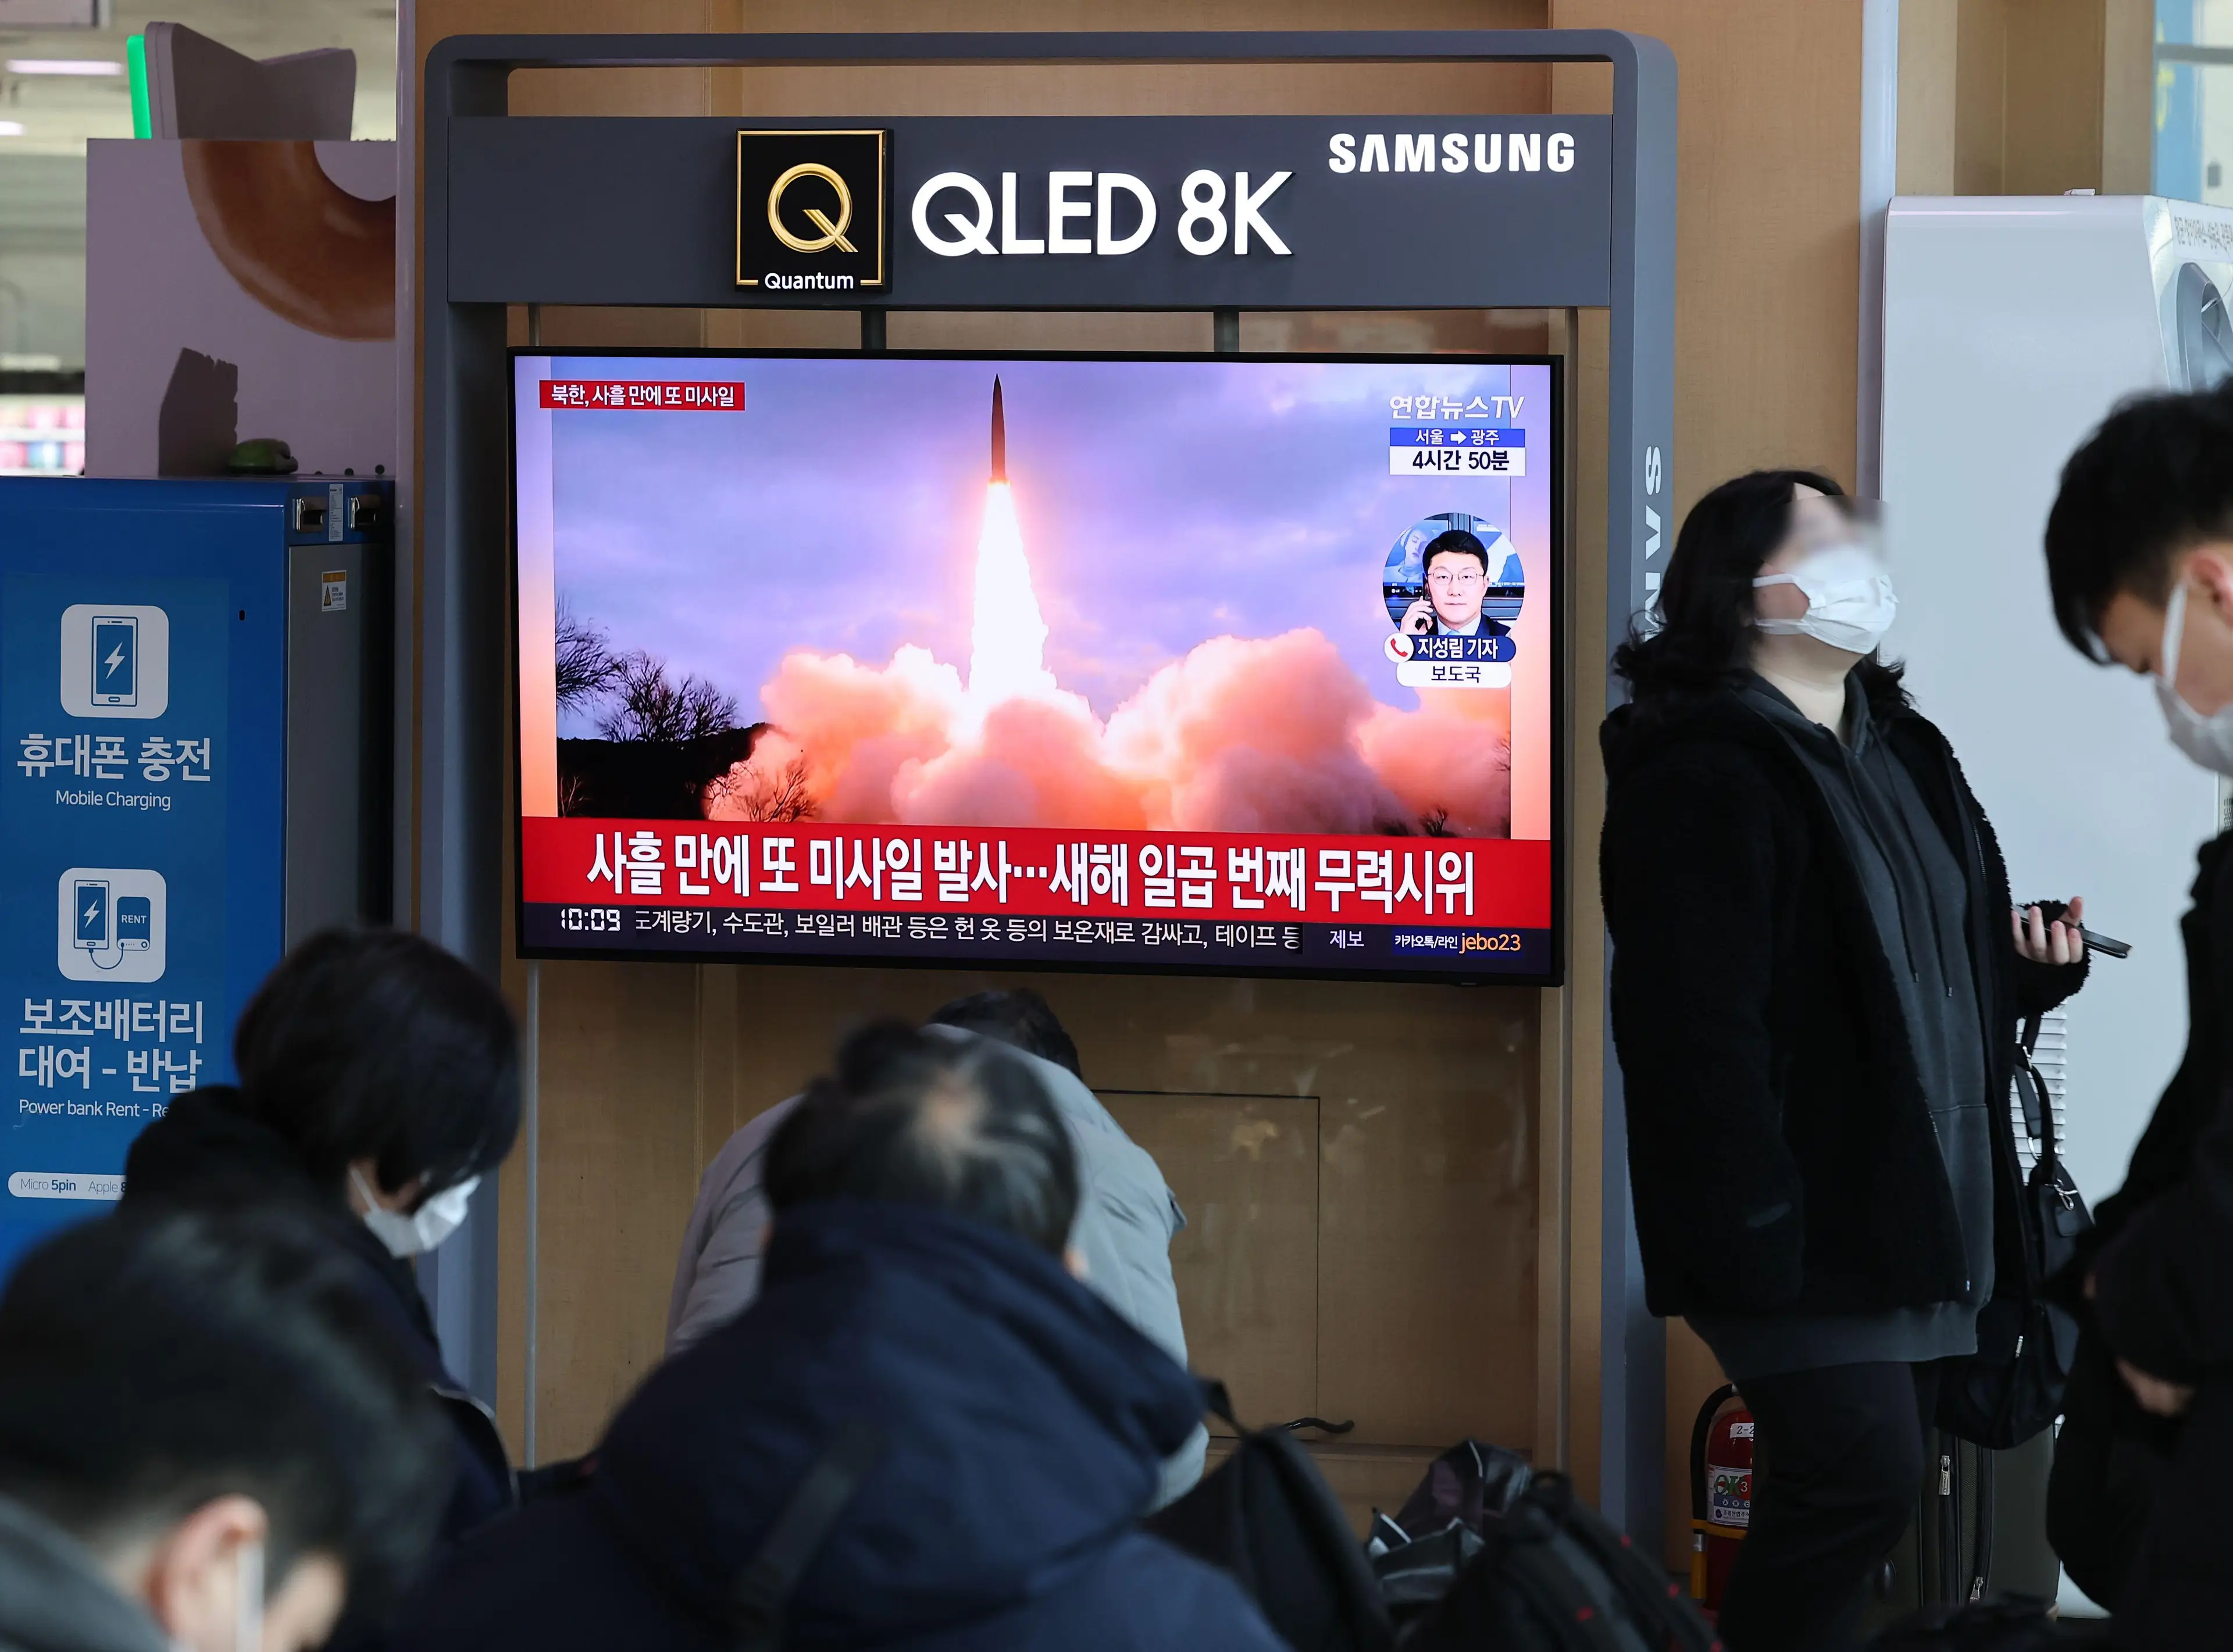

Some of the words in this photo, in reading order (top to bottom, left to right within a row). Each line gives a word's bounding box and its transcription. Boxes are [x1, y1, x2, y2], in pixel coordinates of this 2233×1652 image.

[1329, 133, 1575, 173] SAMSUNG
[768, 163, 858, 253] Q
[911, 172, 1157, 256] QLED
[1178, 169, 1293, 256] 8K
[765, 272, 854, 290] Quantum
[629, 386, 661, 406] 만에
[665, 386, 682, 405] 또
[686, 386, 734, 407] 미사일
[1415, 429, 1444, 445] 서울
[1471, 429, 1500, 445] 광주
[1412, 449, 1461, 470] 4시간
[1468, 450, 1510, 470] 50분
[1418, 637, 1463, 659] 지성림
[1467, 638, 1499, 659] 기자
[1431, 666, 1481, 683] 보도국
[17, 734, 129, 779] 휴대폰
[138, 736, 211, 782] 충전
[56, 790, 103, 806] Mobile
[106, 791, 172, 811] Charging
[587, 831, 666, 895] 사흘
[675, 834, 750, 897] 만에
[759, 837, 799, 892] 또
[810, 837, 922, 901] 미사일
[1139, 844, 1217, 908] 일곱
[1228, 847, 1305, 911] 번째
[1315, 850, 1473, 915] 무력시위
[122, 915, 147, 924] RENT
[561, 908, 621, 932] 10:09
[723, 912, 789, 938] 수도관,
[795, 914, 854, 937] 보일러
[862, 916, 903, 938] 배관
[907, 916, 948, 939] 등은
[954, 917, 975, 940] 헌
[980, 918, 1001, 941] 옷
[1006, 919, 1047, 942] 등의
[1053, 920, 1136, 944] 보온재로
[1142, 922, 1207, 949] 감싸고,
[1215, 924, 1277, 948] 테이프
[1282, 926, 1300, 950] 등
[1329, 929, 1365, 949] 제보
[1394, 934, 1458, 949] 카카오톡/라인
[1459, 933, 1521, 954] jebo23
[20, 998, 202, 1044] 보조배터리
[19, 1045, 90, 1089] 대여
[127, 1048, 202, 1094] 반납
[19, 1099, 65, 1114] Power
[67, 1100, 103, 1116] bank
[106, 1102, 140, 1117] Rent
[20, 1178, 49, 1190] Micro
[51, 1179, 76, 1193] 5pin
[88, 1180, 119, 1195] Apple
